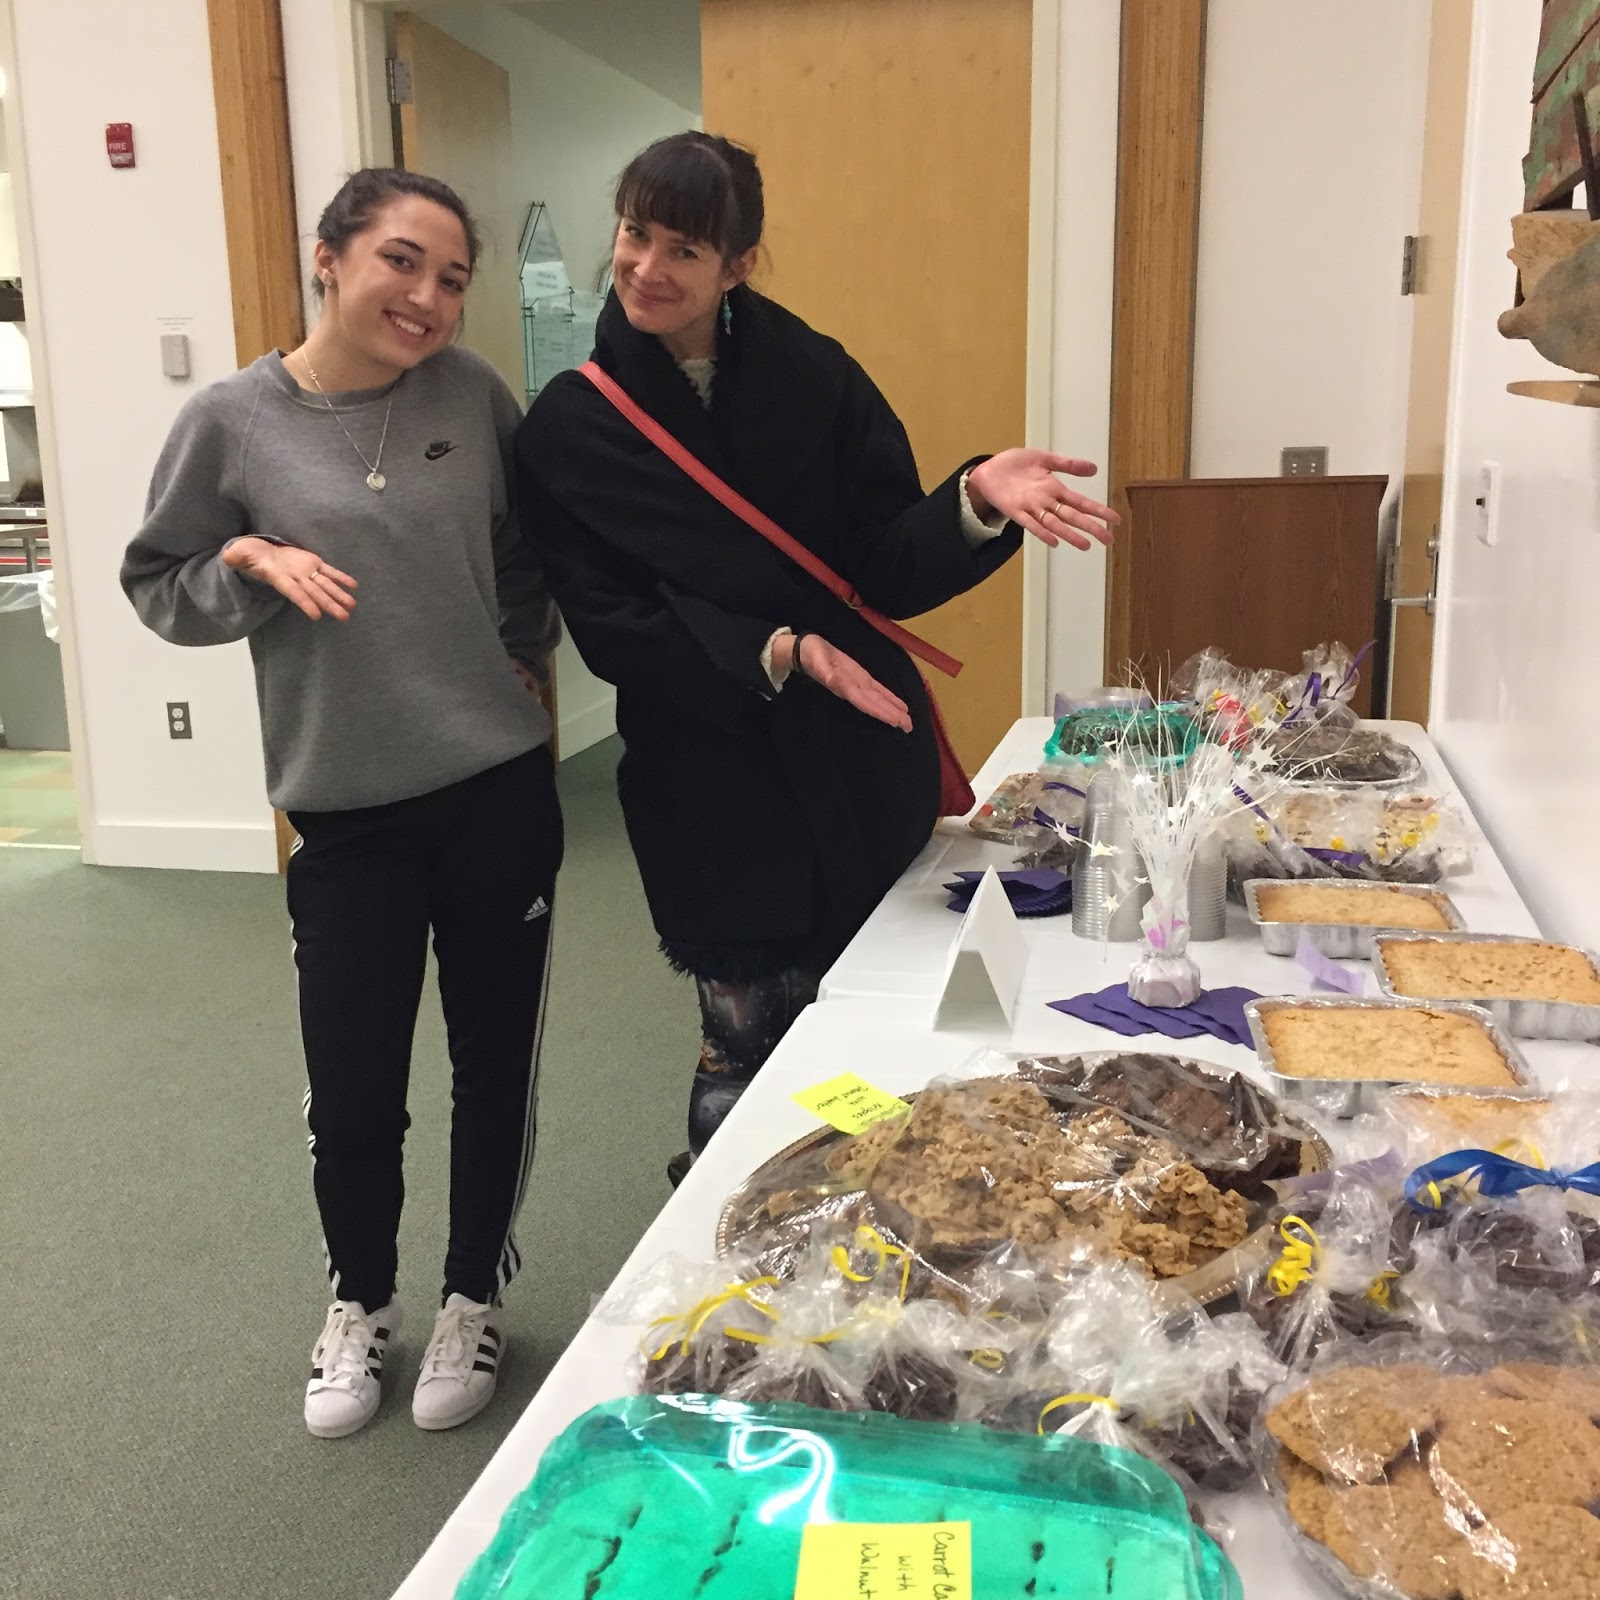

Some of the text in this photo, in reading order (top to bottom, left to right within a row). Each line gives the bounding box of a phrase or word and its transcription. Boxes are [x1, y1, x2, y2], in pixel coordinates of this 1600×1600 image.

[109, 142, 127, 151] FIRE
[932, 1531, 956, 1578] Carrot
[896, 1555, 917, 1592] with
